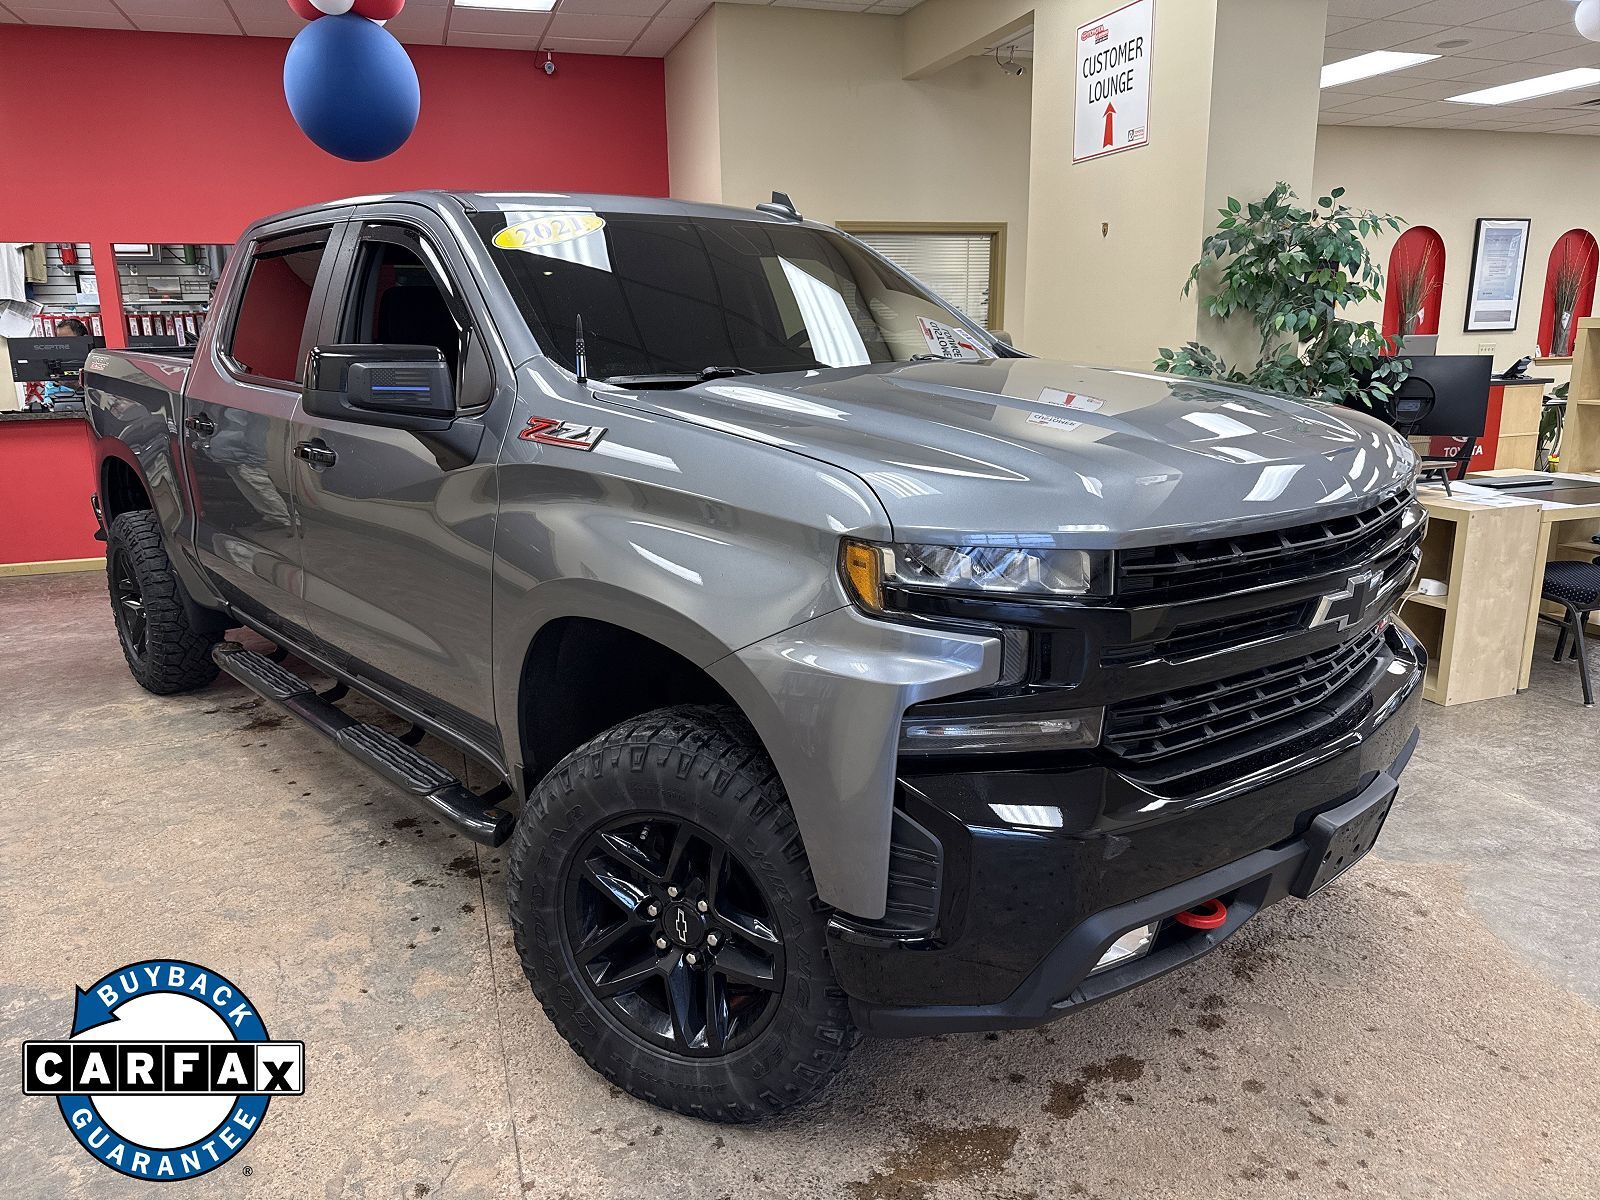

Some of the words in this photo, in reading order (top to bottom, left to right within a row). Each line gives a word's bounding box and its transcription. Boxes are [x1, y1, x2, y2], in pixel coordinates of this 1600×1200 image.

[1083, 36, 1143, 78] CUSTOMER
[1089, 69, 1134, 104] LOUNGE
[516, 216, 582, 245] 2021
[1443, 444, 1484, 457] TOTA
